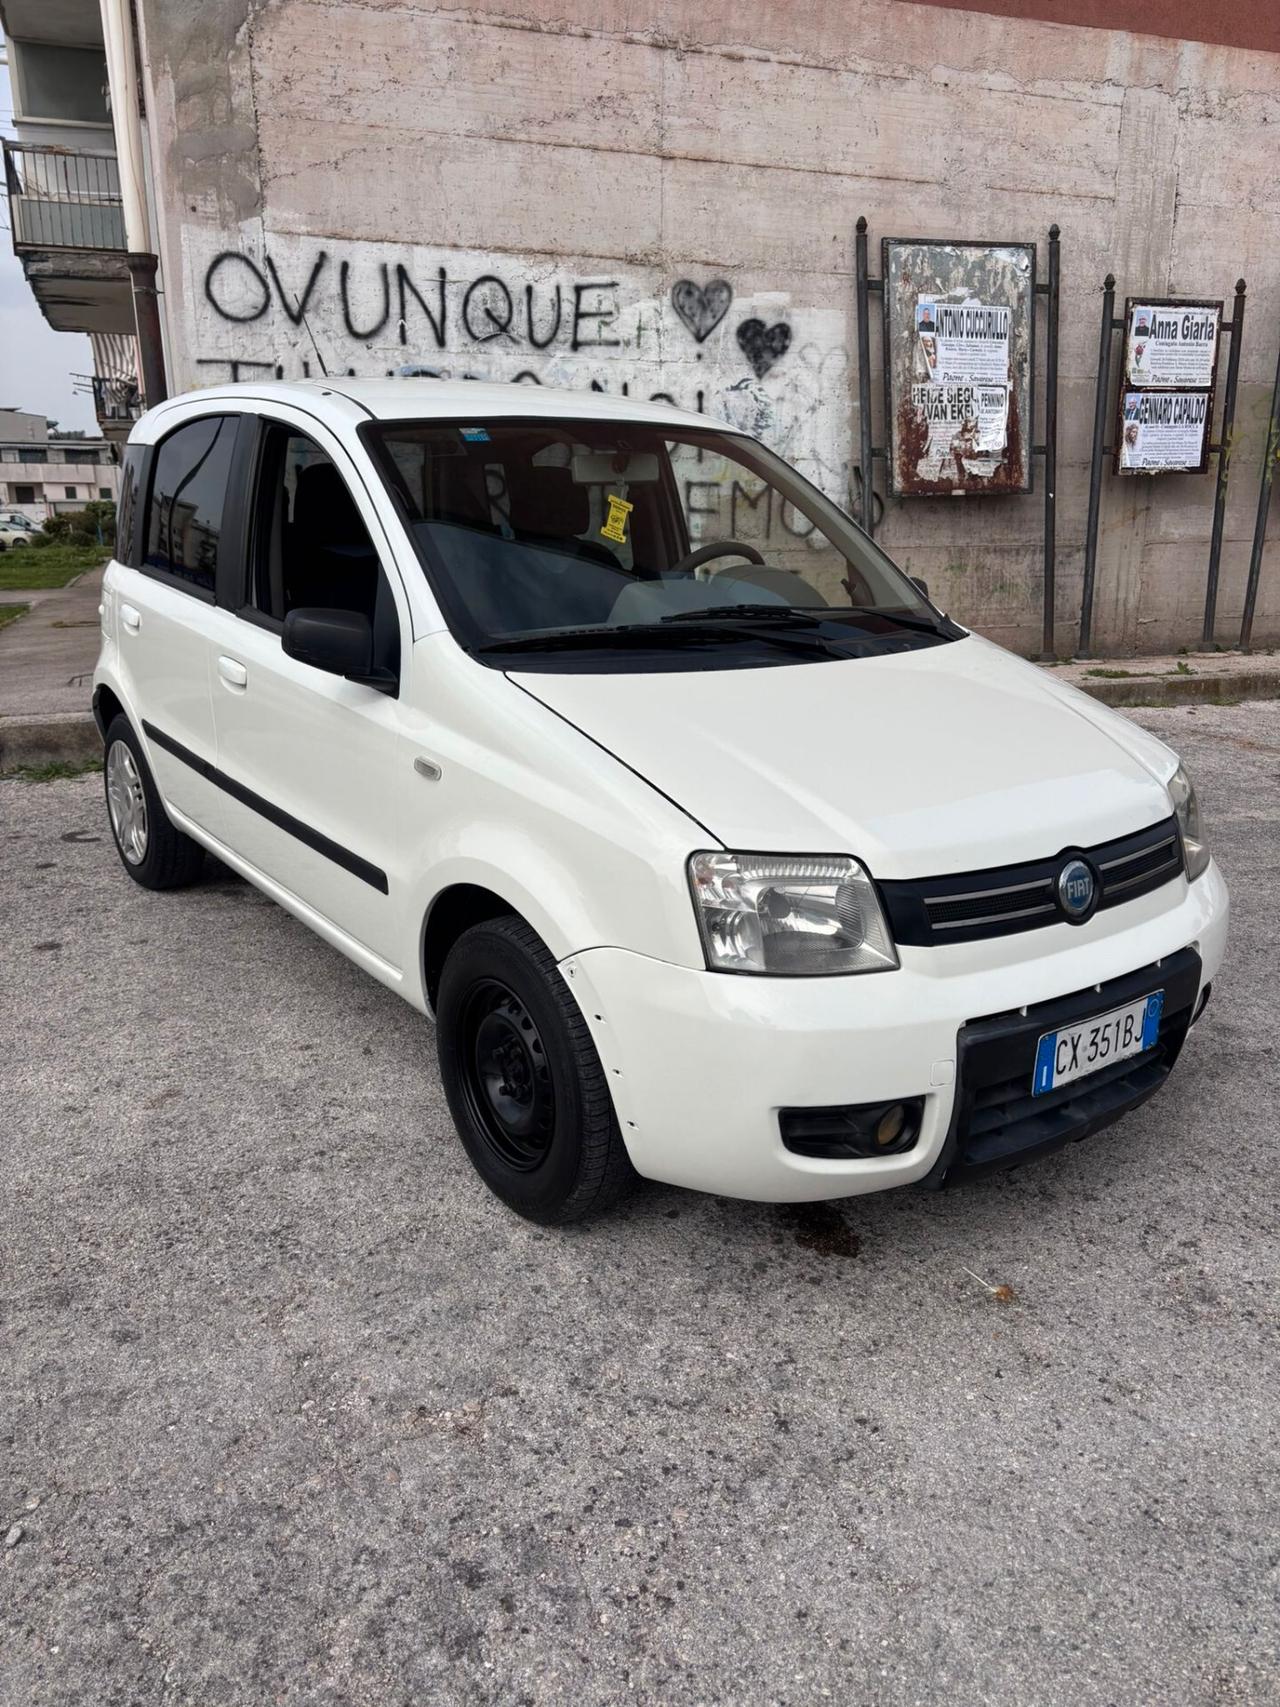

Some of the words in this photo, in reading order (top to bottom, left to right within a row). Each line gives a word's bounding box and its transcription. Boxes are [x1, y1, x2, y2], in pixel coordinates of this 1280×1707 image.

[205, 251, 621, 350] OVUNQUE
[935, 309, 964, 338] ANTONIO
[1149, 314, 1178, 339] Anna
[1182, 315, 1214, 340] Giarla
[927, 405, 948, 420] VAN
[1140, 398, 1173, 424] GENNARO
[1173, 398, 1206, 424] CAPALDO
[1067, 877, 1090, 900] FIAT
[1055, 1034, 1082, 1076] CX
[1087, 1007, 1145, 1063] 351BJ
